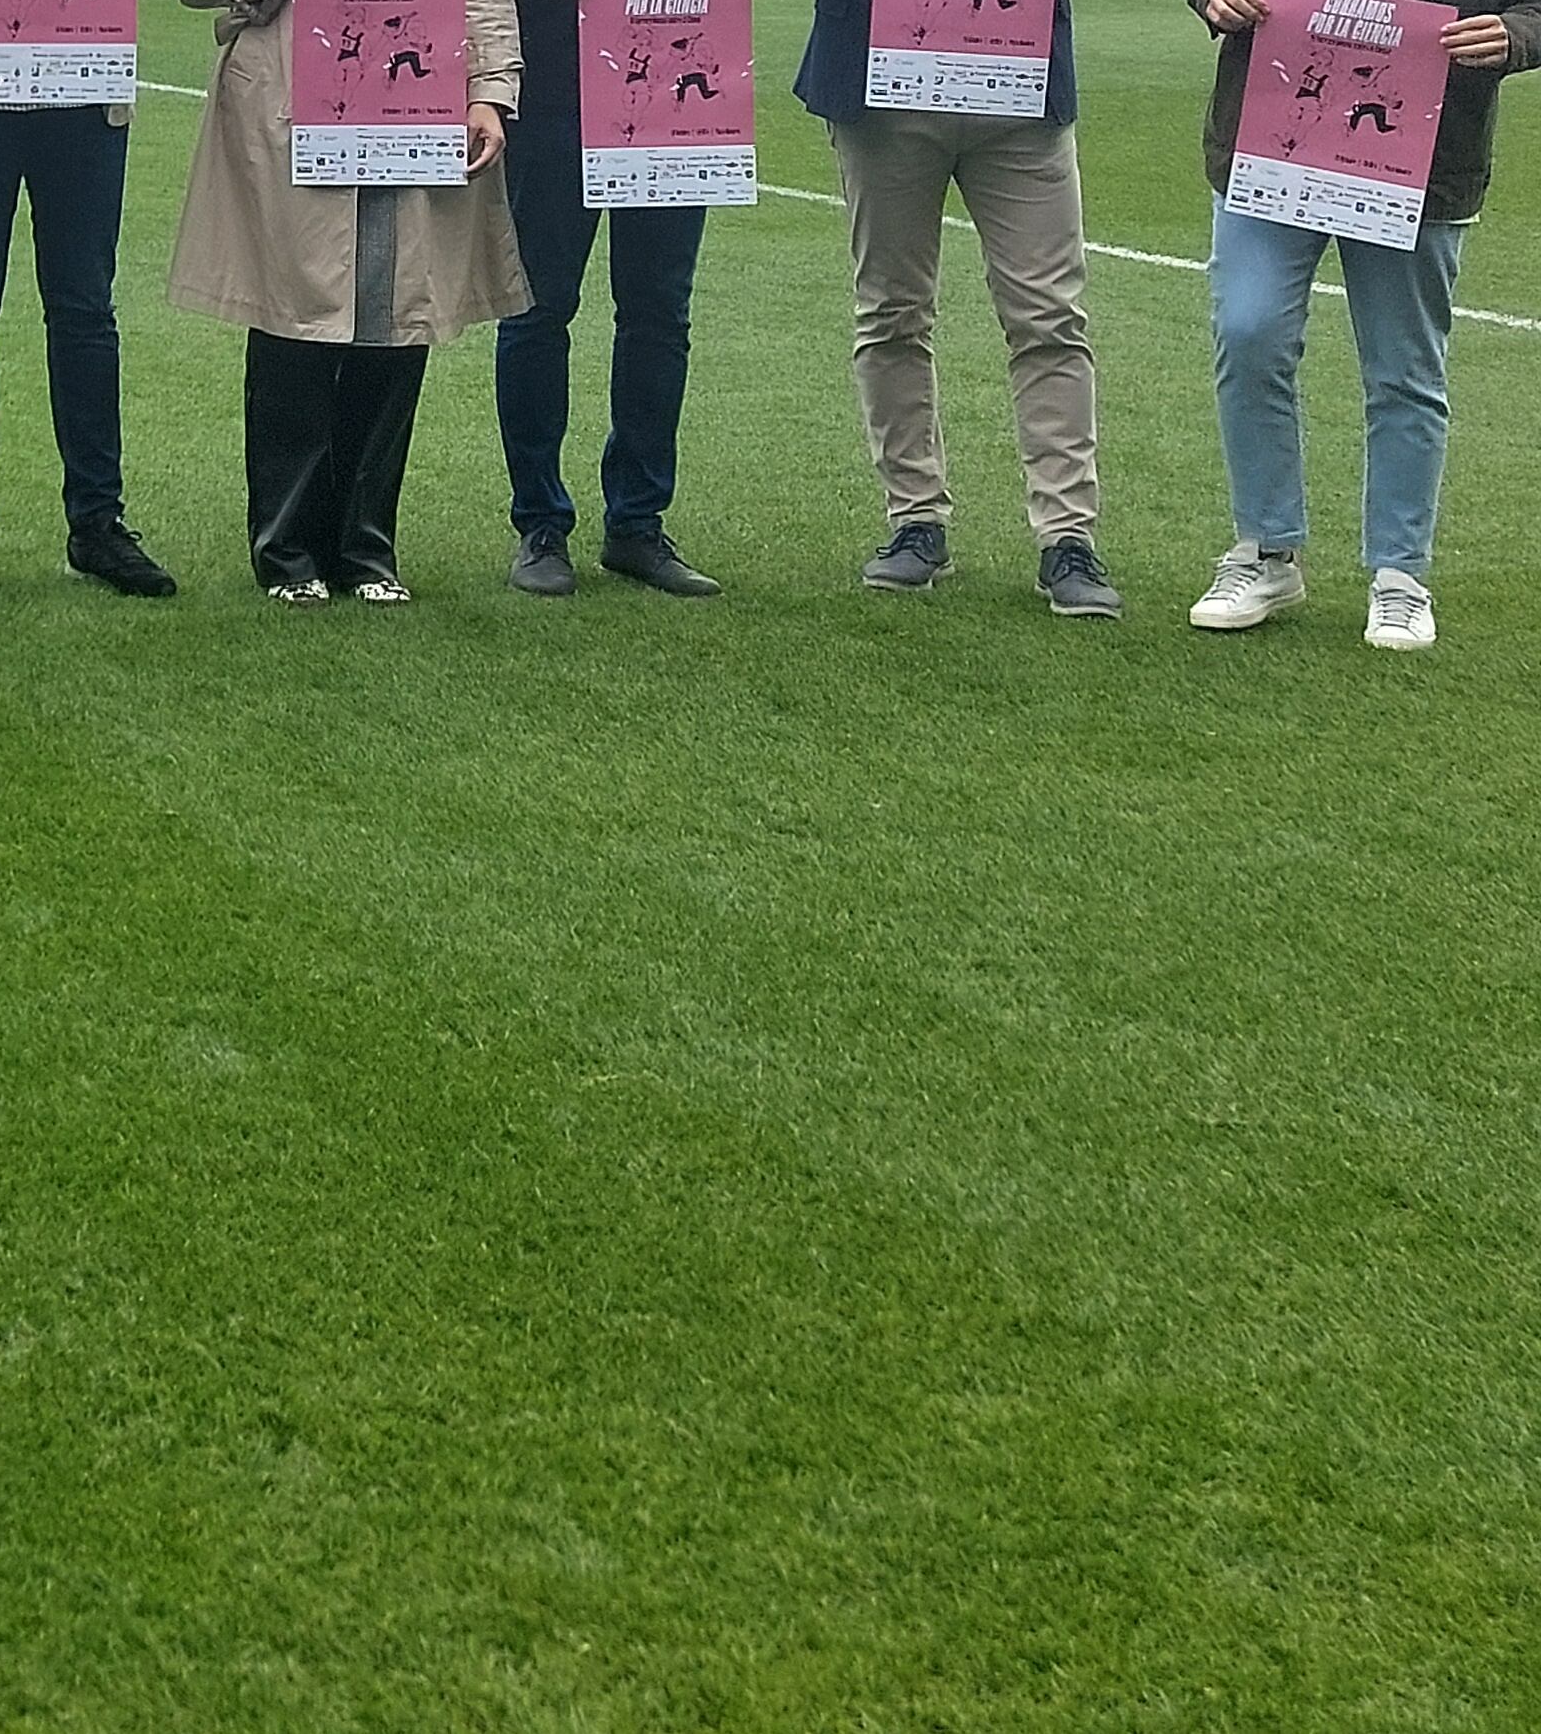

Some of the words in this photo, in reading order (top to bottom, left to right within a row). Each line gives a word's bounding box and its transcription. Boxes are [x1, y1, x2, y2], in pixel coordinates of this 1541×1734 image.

[1307, 12, 1337, 35] POR
[1337, 18, 1354, 38] LA
[1354, 21, 1403, 47] CIENCIA
